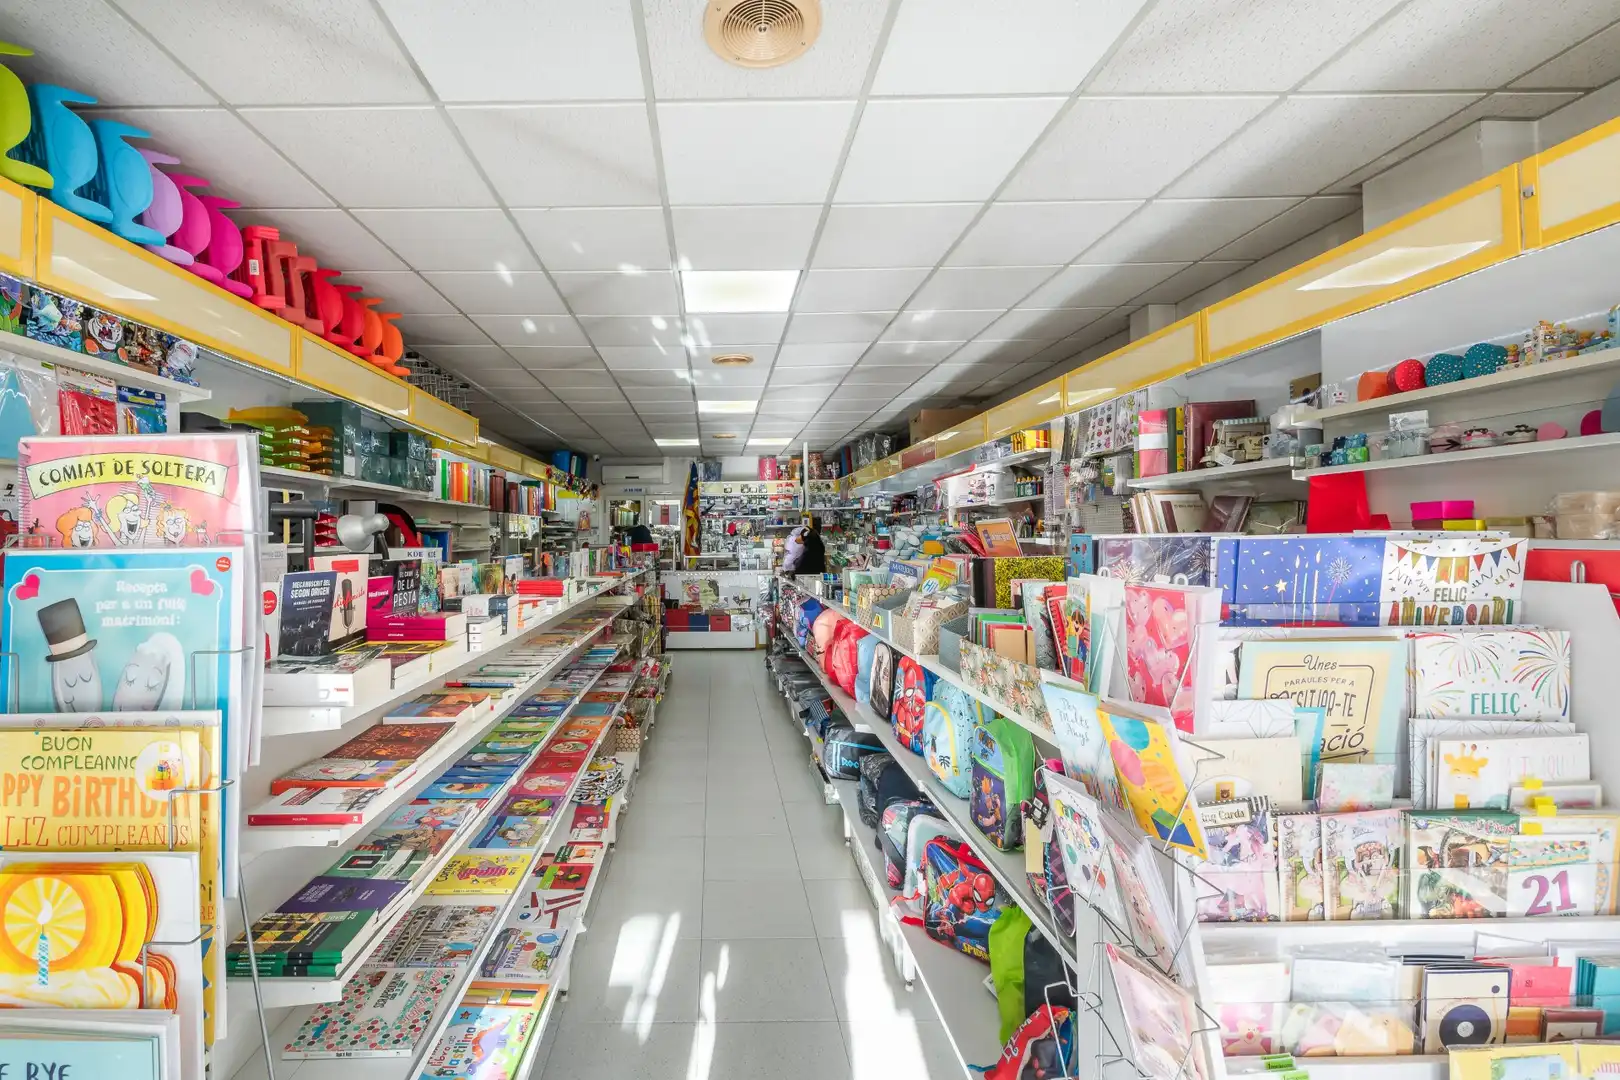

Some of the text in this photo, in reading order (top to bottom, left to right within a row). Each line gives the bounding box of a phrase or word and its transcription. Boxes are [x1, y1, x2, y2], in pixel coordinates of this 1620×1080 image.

[39, 459, 216, 487] COMIAT DE SOLTERA
[290, 588, 311, 599] SEGON
[397, 579, 415, 591] DE LA
[393, 590, 417, 607] PESTA
[1434, 586, 1467, 605] FELIÇ
[94, 600, 117, 614] per
[135, 600, 153, 610] un
[1388, 596, 1514, 626] ANIVERSARI
[101, 613, 181, 627] matrimoni:
[1303, 654, 1337, 671] Unes
[1284, 676, 1328, 688] PARAULES
[1331, 677, 1345, 685] PER
[1470, 692, 1521, 716] FELIÇ
[41, 736, 92, 752] BUON
[2, 772, 44, 807] PPY
[1201, 808, 1245, 824] ing Cards
[4, 815, 49, 848] LIZ
[1522, 870, 1577, 916] 21
[430, 1046, 451, 1066] libro
